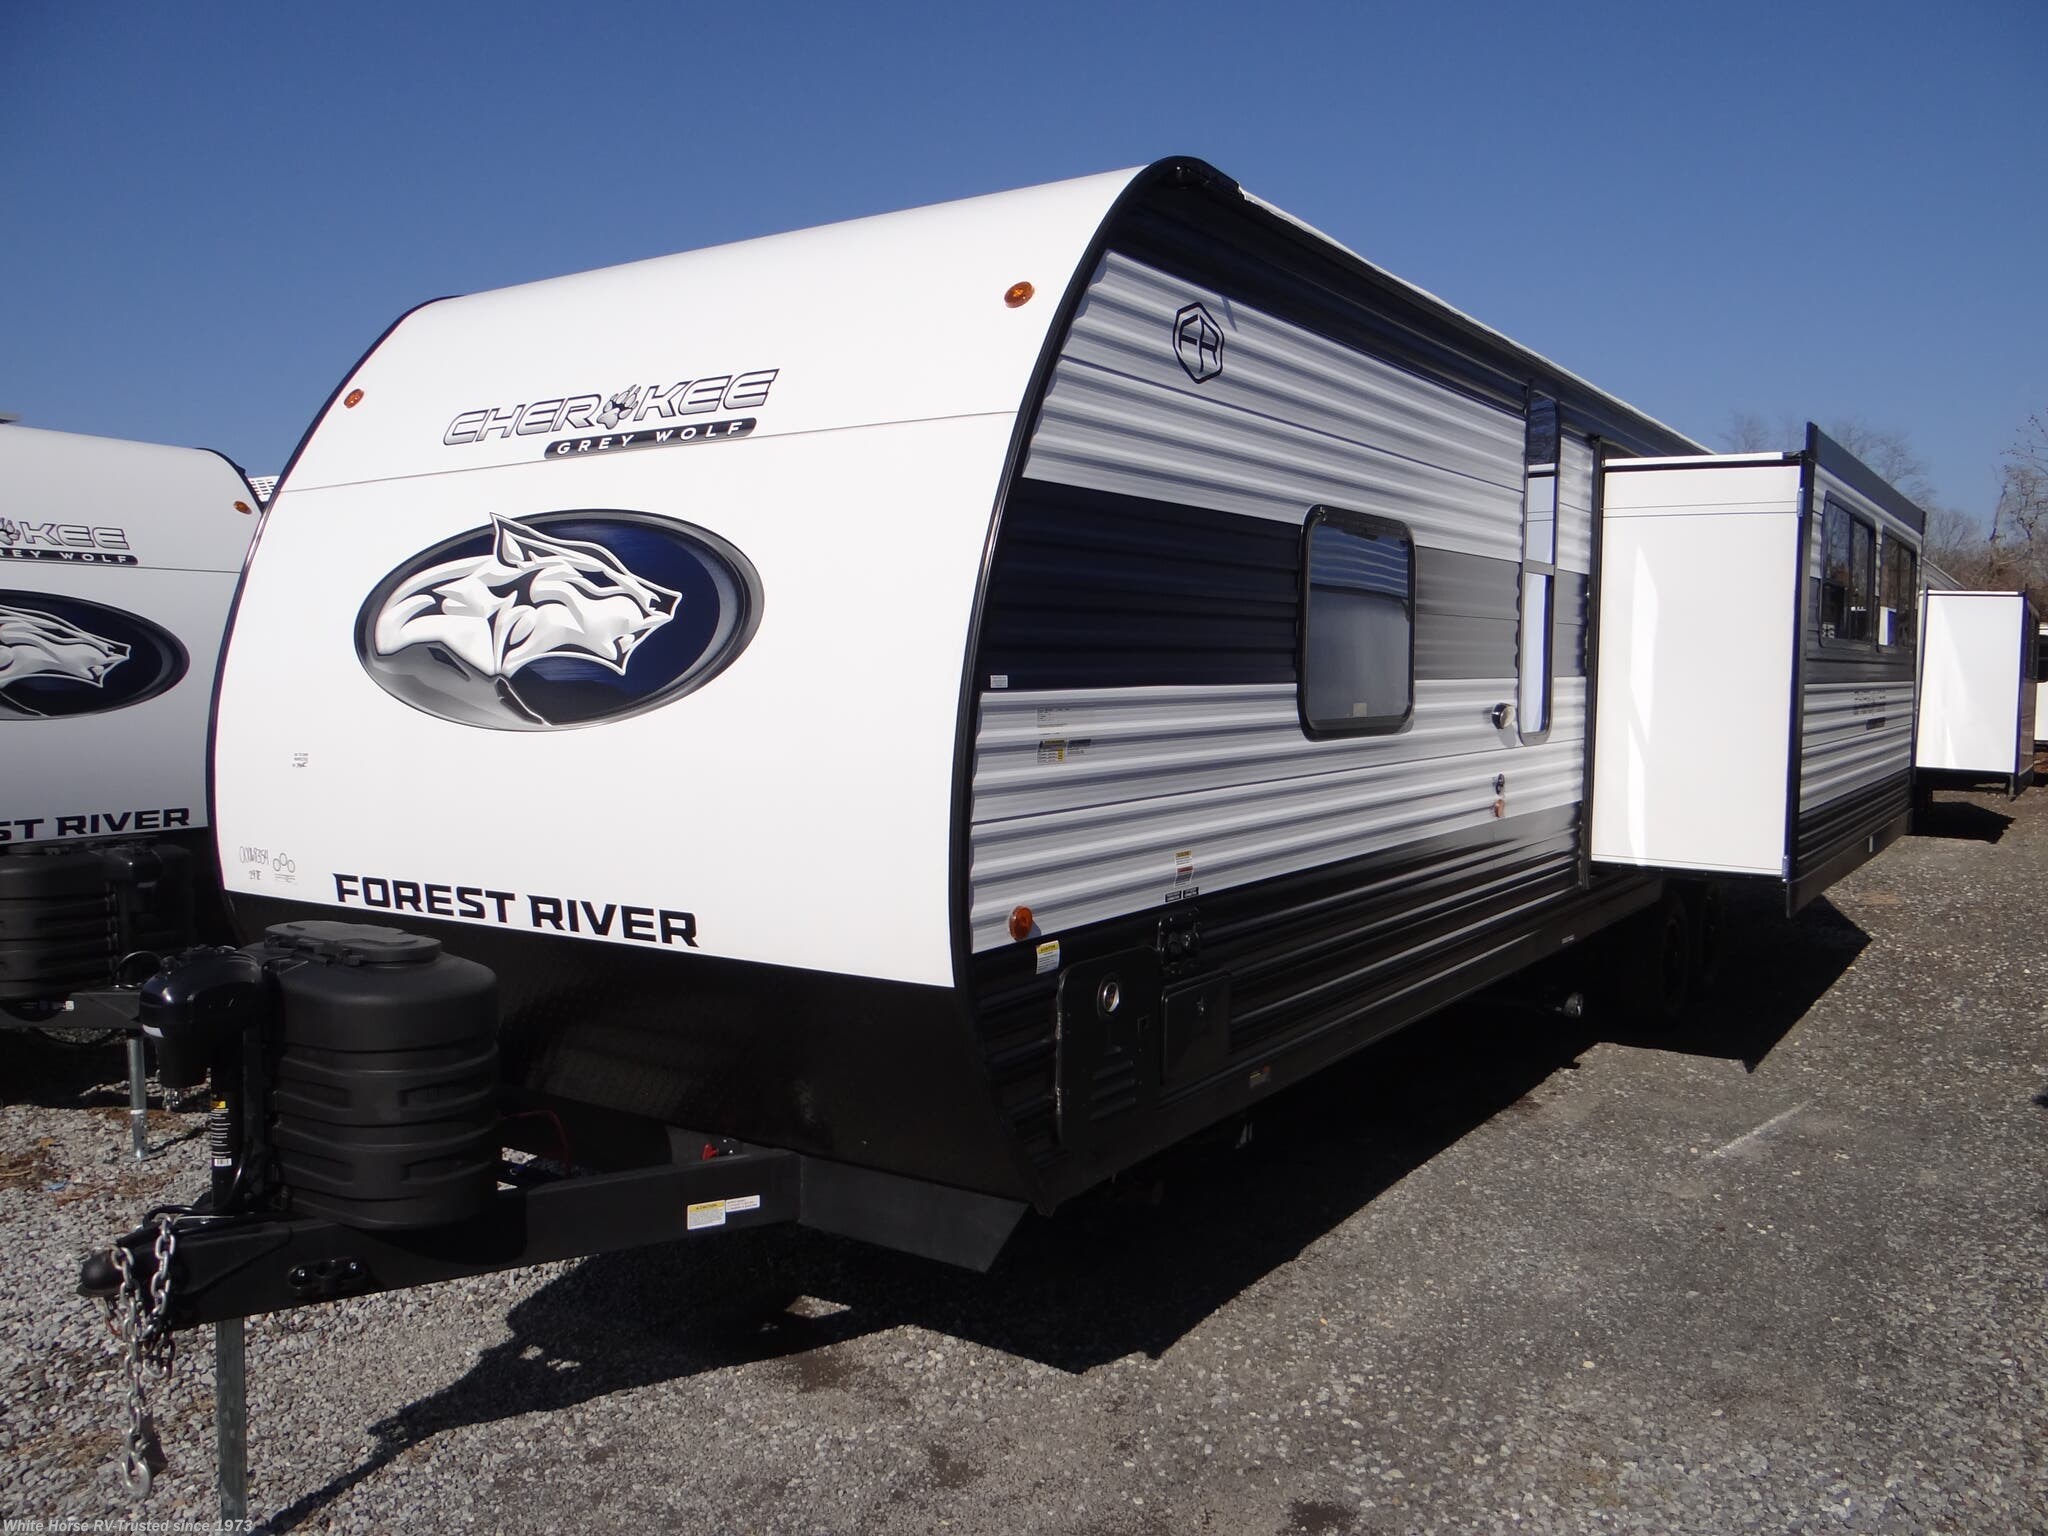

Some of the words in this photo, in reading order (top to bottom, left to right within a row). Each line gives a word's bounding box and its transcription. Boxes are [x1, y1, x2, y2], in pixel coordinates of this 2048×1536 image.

[557, 434, 635, 455] GREY
[655, 421, 743, 444] WOLF
[60, 552, 127, 563] WOLF
[56, 807, 190, 837] RIVER
[332, 872, 516, 924] FOREST
[526, 894, 701, 948] RIVER
